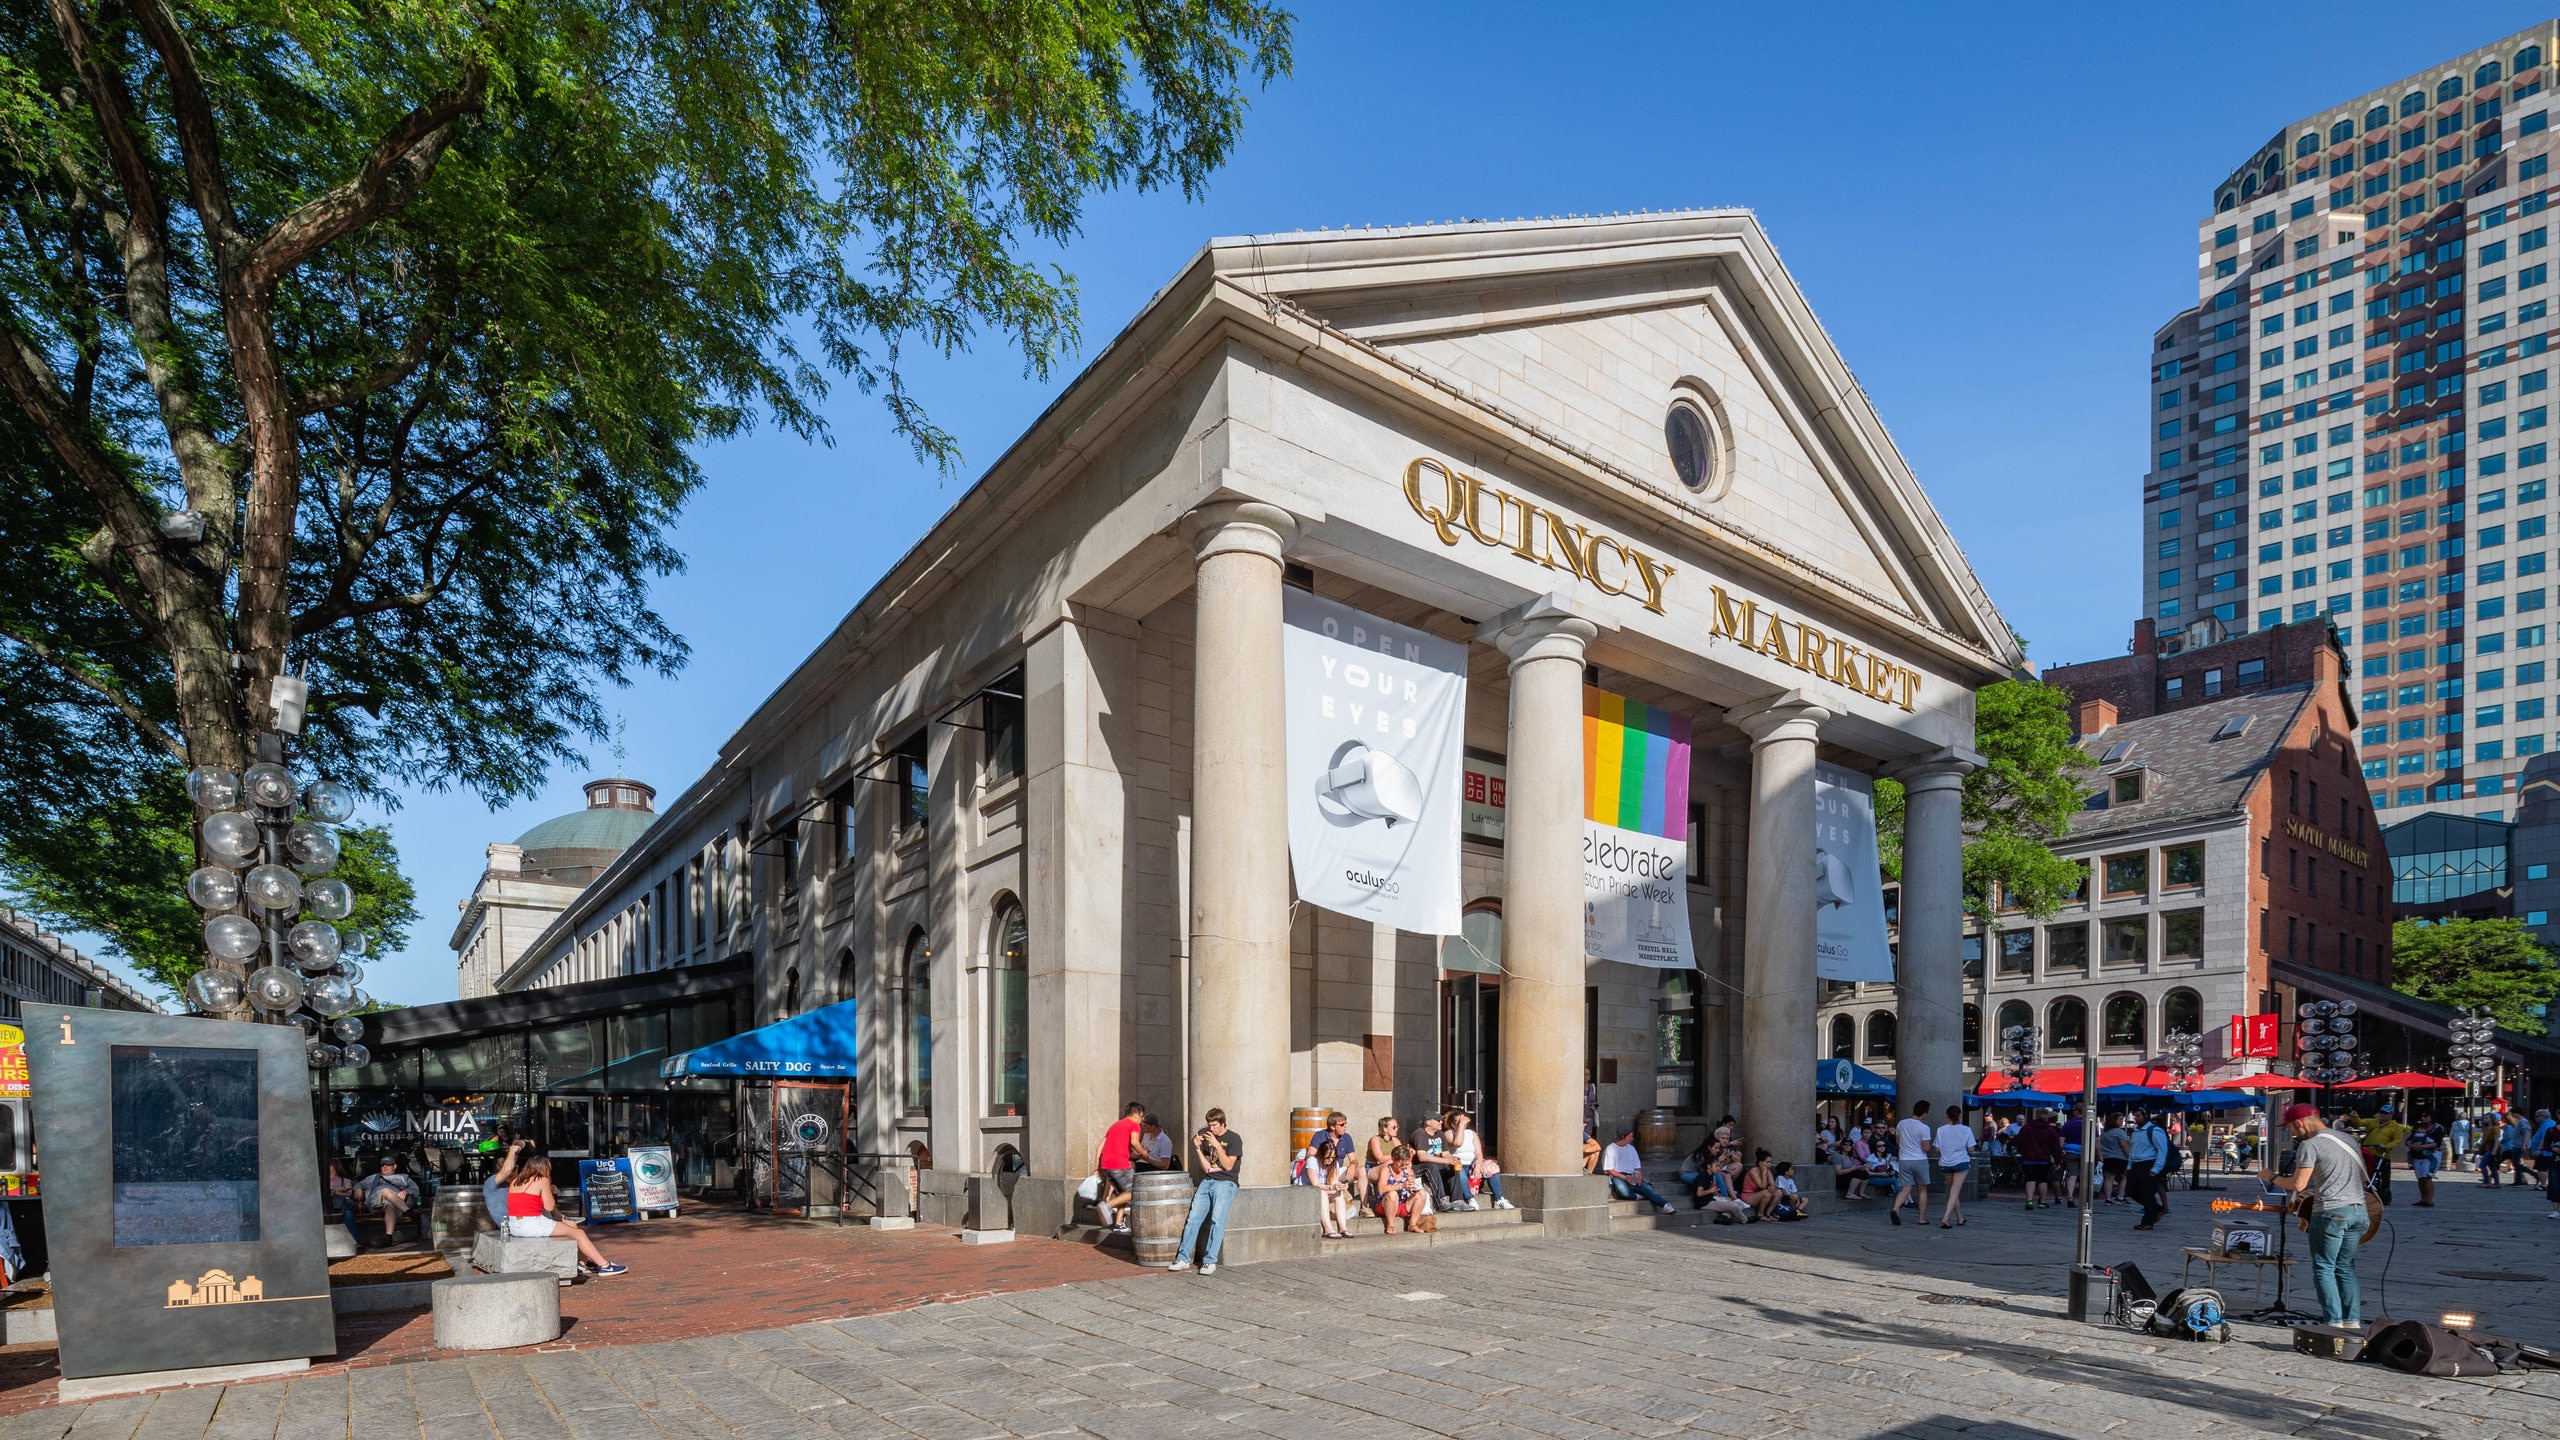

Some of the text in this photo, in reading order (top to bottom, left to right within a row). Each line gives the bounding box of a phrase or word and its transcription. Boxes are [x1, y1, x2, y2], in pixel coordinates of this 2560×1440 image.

[1402, 456, 1922, 713] QUINCY MARKET
[1322, 616, 1420, 664] OPEN
[1321, 654, 1417, 704] YOUR
[1322, 694, 1417, 739] EYES
[1493, 793, 1505, 805] QL
[2286, 817, 2369, 869] SOUTH MARKET
[1346, 870, 1385, 889] oculus
[1609, 875, 1638, 899] Pride
[1641, 882, 1675, 905] Week
[1638, 953, 1679, 962] MARKETPLACE
[1662, 946, 1677, 954] HALL
[0, 1057, 27, 1068] LE
[745, 1061, 812, 1072] SALTY DOG
[406, 1110, 480, 1132] MIJA
[361, 1132, 400, 1140] Cantina
[596, 1160, 615, 1168] UFO
[2230, 1231, 2262, 1242] TIPS
